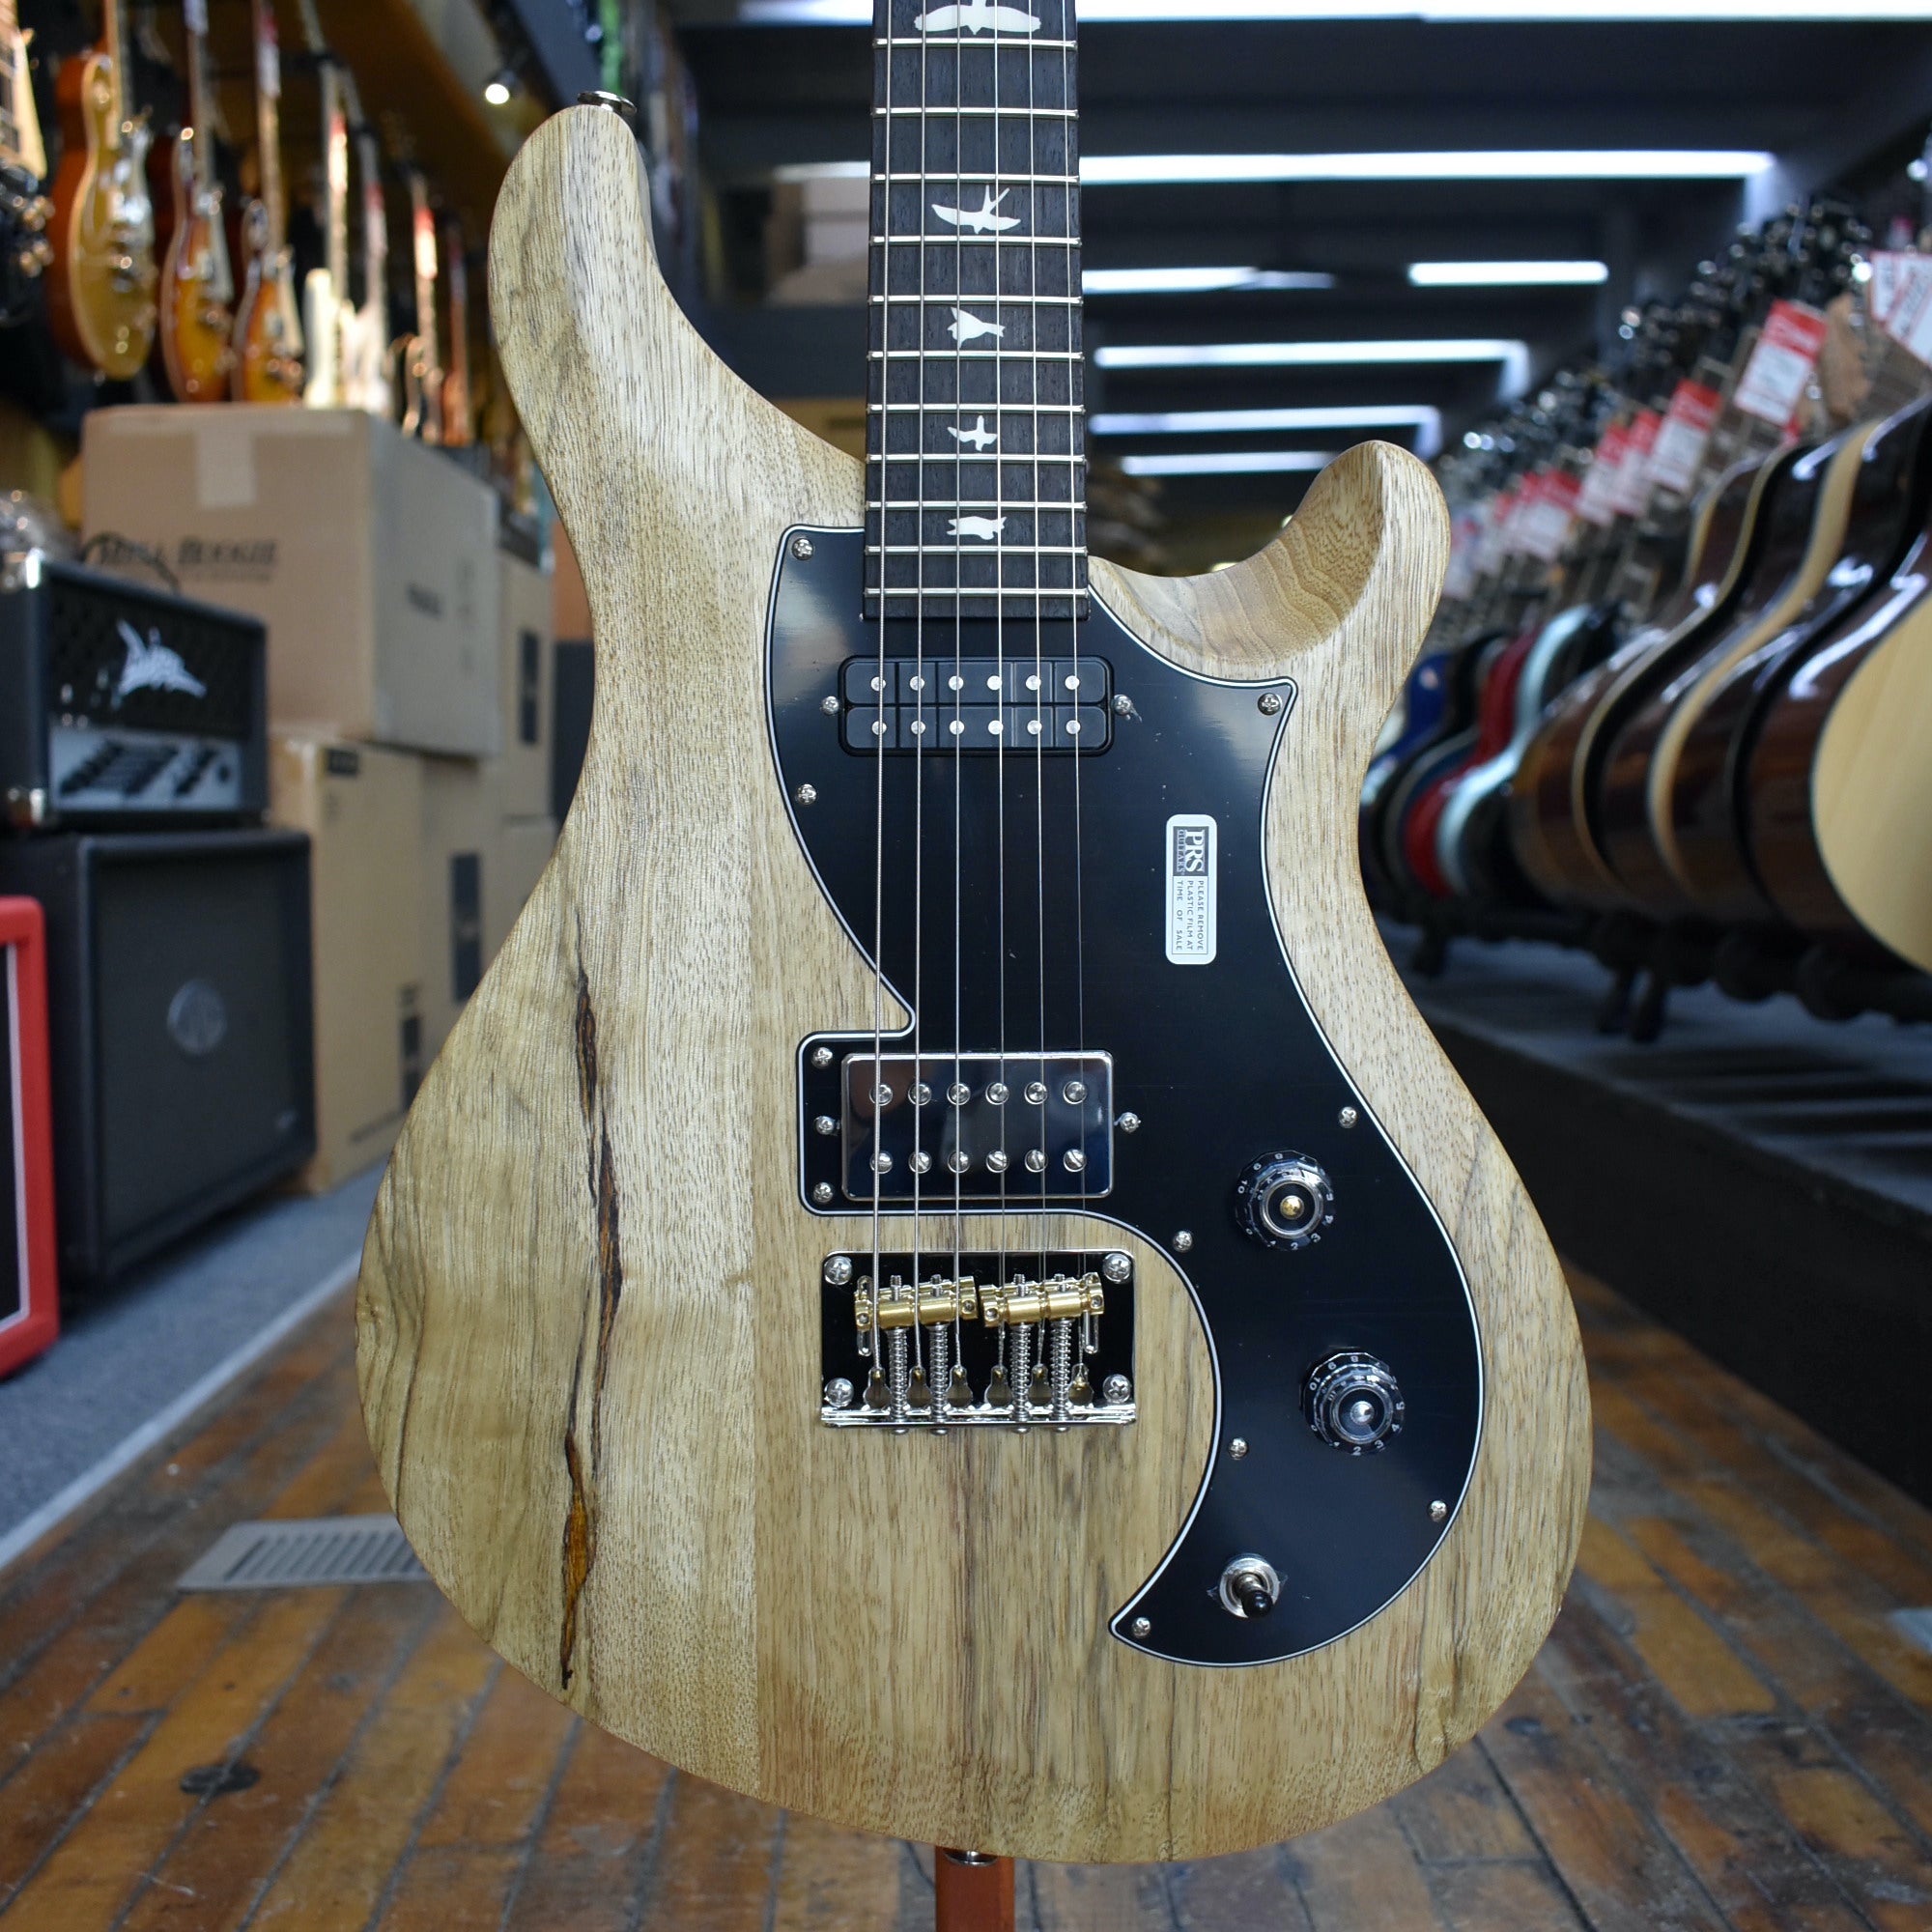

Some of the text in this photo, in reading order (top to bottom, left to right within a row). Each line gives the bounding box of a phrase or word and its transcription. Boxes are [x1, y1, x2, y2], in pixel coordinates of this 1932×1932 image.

[1184, 829, 1206, 873] PRS
[1176, 909, 1183, 922] OF
[1186, 940, 1194, 951] AT
[1237, 1179, 1248, 1194] 10
[1311, 1233, 1321, 1242] 3
[1309, 1377, 1321, 1390] 10
[1351, 1446, 1362, 1456] 2
